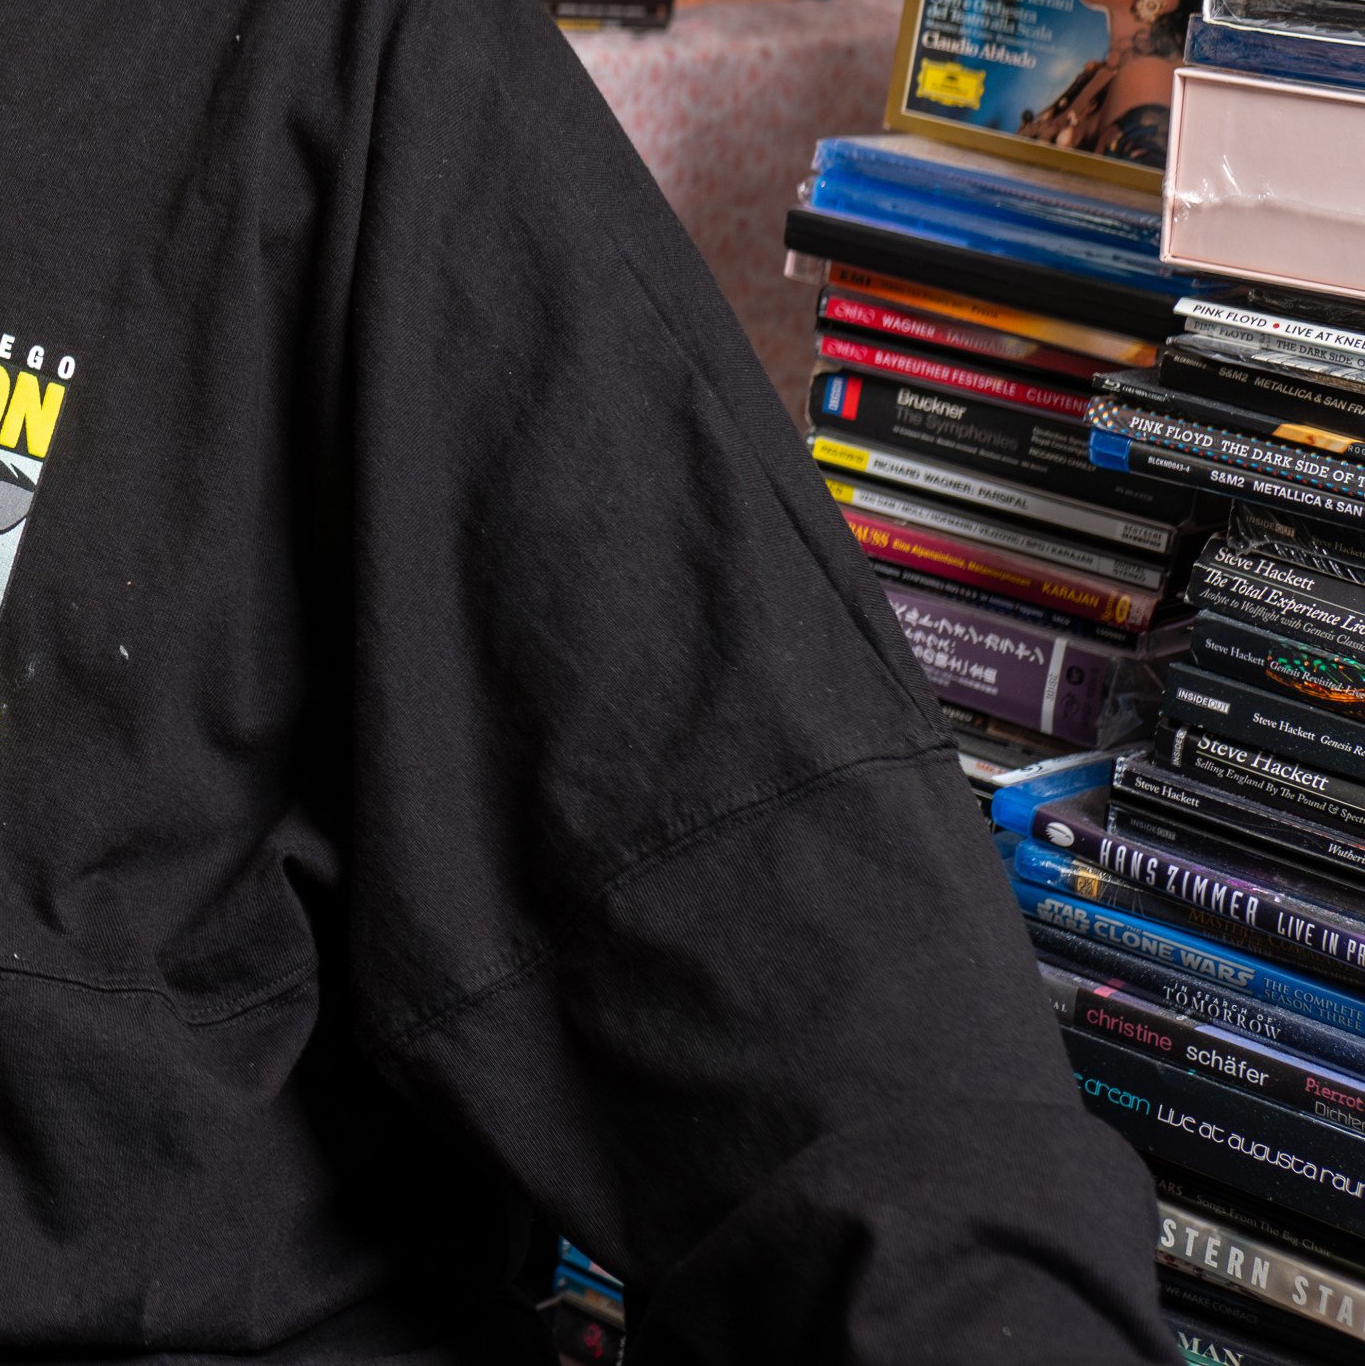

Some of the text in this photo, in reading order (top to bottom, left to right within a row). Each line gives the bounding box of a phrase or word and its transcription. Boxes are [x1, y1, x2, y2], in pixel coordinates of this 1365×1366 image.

[922, 32, 978, 58] Claudio
[980, 43, 1037, 70] Abbado
[882, 313, 935, 339] WAGNER
[1193, 304, 1332, 342] PINK FLOYD LIVE AT
[1193, 322, 1352, 365] PINK FLOYD THE DARK SIDE
[874, 351, 949, 381] BAYREUTHER
[951, 366, 1016, 397] FESTSPIELE
[1219, 367, 1346, 410] S&M2 METALLICA & SAN
[897, 387, 967, 420] Bruckner
[895, 407, 923, 424] The
[925, 412, 1019, 453] Symphonies
[1130, 416, 1354, 484] PINK FLOYD THE DARK SIDE OF
[873, 459, 920, 480] RICHARD
[978, 488, 1029, 511] PARSIFAL
[1210, 470, 1364, 518] S&M2 METALLICA & SAN
[1051, 544, 1093, 566] KARAJAN
[1215, 547, 1315, 591] Steve Hackett
[1041, 583, 1099, 609] KARAJAN
[1200, 587, 1336, 641] Acolyte to Wolflight with Genesis
[1204, 567, 1341, 626] The Total Experience
[1205, 638, 1344, 693] Steve Hackett Genesis Revisited:
[1177, 688, 1352, 753] INSIDEOUT Steve Hackett Genesis
[1197, 733, 1329, 791] Steve Hackett
[1135, 776, 1200, 808] Steve Hackett
[1195, 757, 1338, 815] Selling England By The Pound &
[1037, 898, 1090, 922] STAR
[1100, 838, 1158, 886] HANS
[1166, 865, 1259, 926] ZIMMER
[1278, 911, 1315, 946] LIVE
[1322, 928, 1340, 955] IN
[1038, 910, 1090, 934] WARS
[1124, 924, 1143, 935] THE
[1094, 920, 1175, 962] CLONE
[1179, 949, 1257, 989] WARS
[1163, 985, 1282, 1041] TOMORROW
[1172, 981, 1188, 992] IN
[1196, 990, 1249, 1016] SEARCH
[1263, 977, 1364, 1022] THE COMPLETE
[1263, 988, 1363, 1032] SEASON THREE
[1086, 1009, 1269, 1087] christine schäfer
[1305, 1076, 1365, 1113] Pierrot
[1156, 1104, 1196, 1135] Live
[1198, 1121, 1225, 1143] at
[1227, 1133, 1318, 1180] augusta
[1197, 1194, 1333, 1259] Songs From The Big Chair
[1160, 1218, 1270, 1291] STERN
[1183, 1291, 1212, 1310] MAKE
[1212, 1301, 1260, 1325] CONTACT
